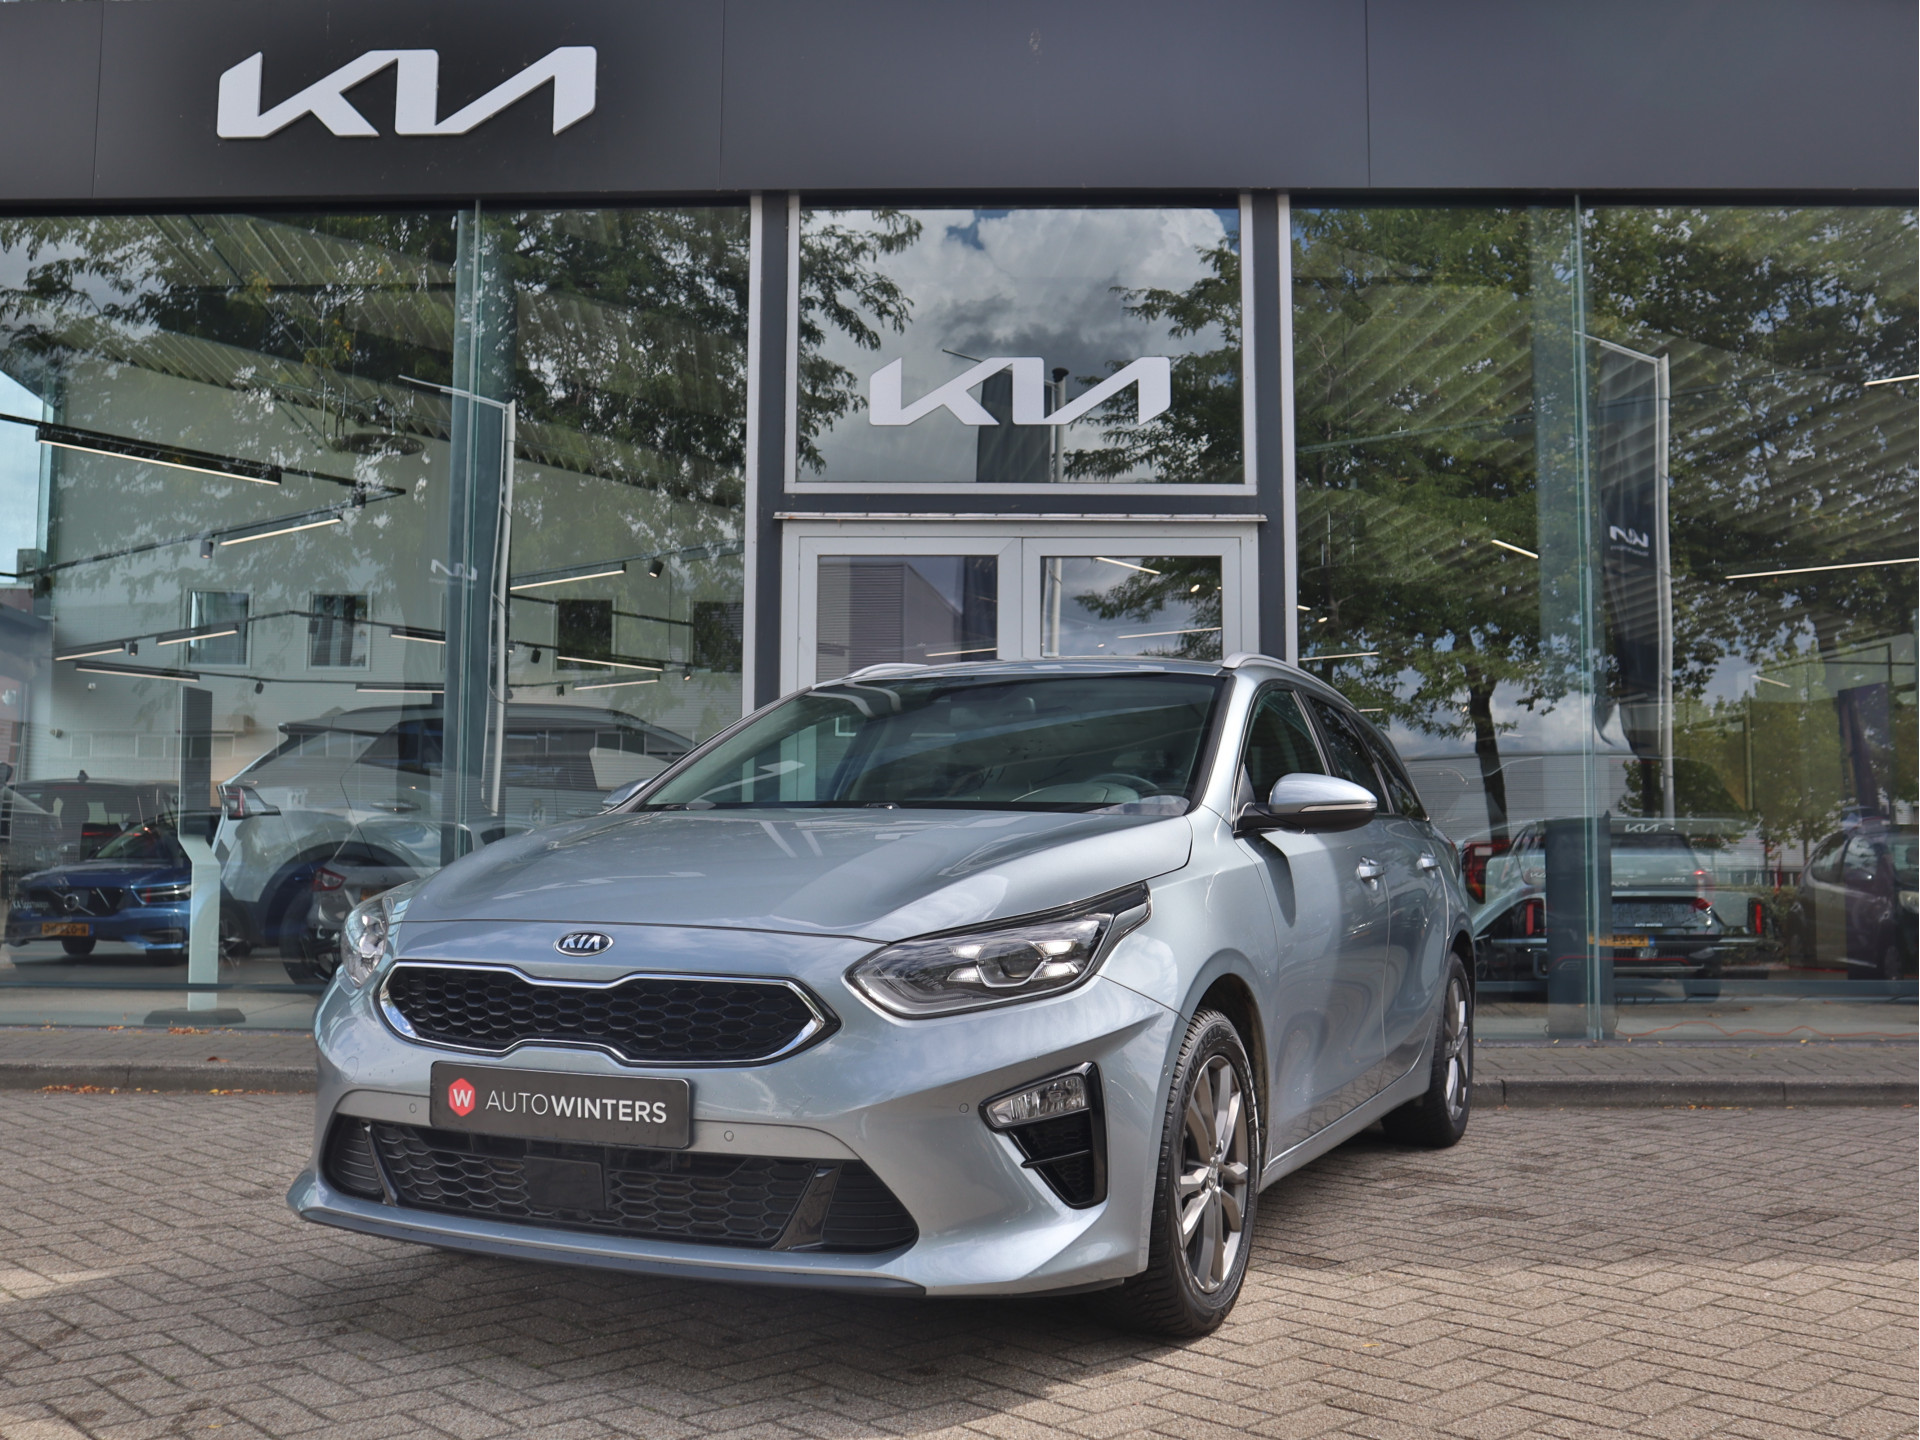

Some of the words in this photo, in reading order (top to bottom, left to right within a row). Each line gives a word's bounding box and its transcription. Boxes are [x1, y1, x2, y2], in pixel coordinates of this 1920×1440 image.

[217, 46, 597, 138] KIA
[869, 356, 1171, 426] KIA
[561, 934, 602, 950] KIA
[485, 1090, 668, 1124] AUTOWINTERS
